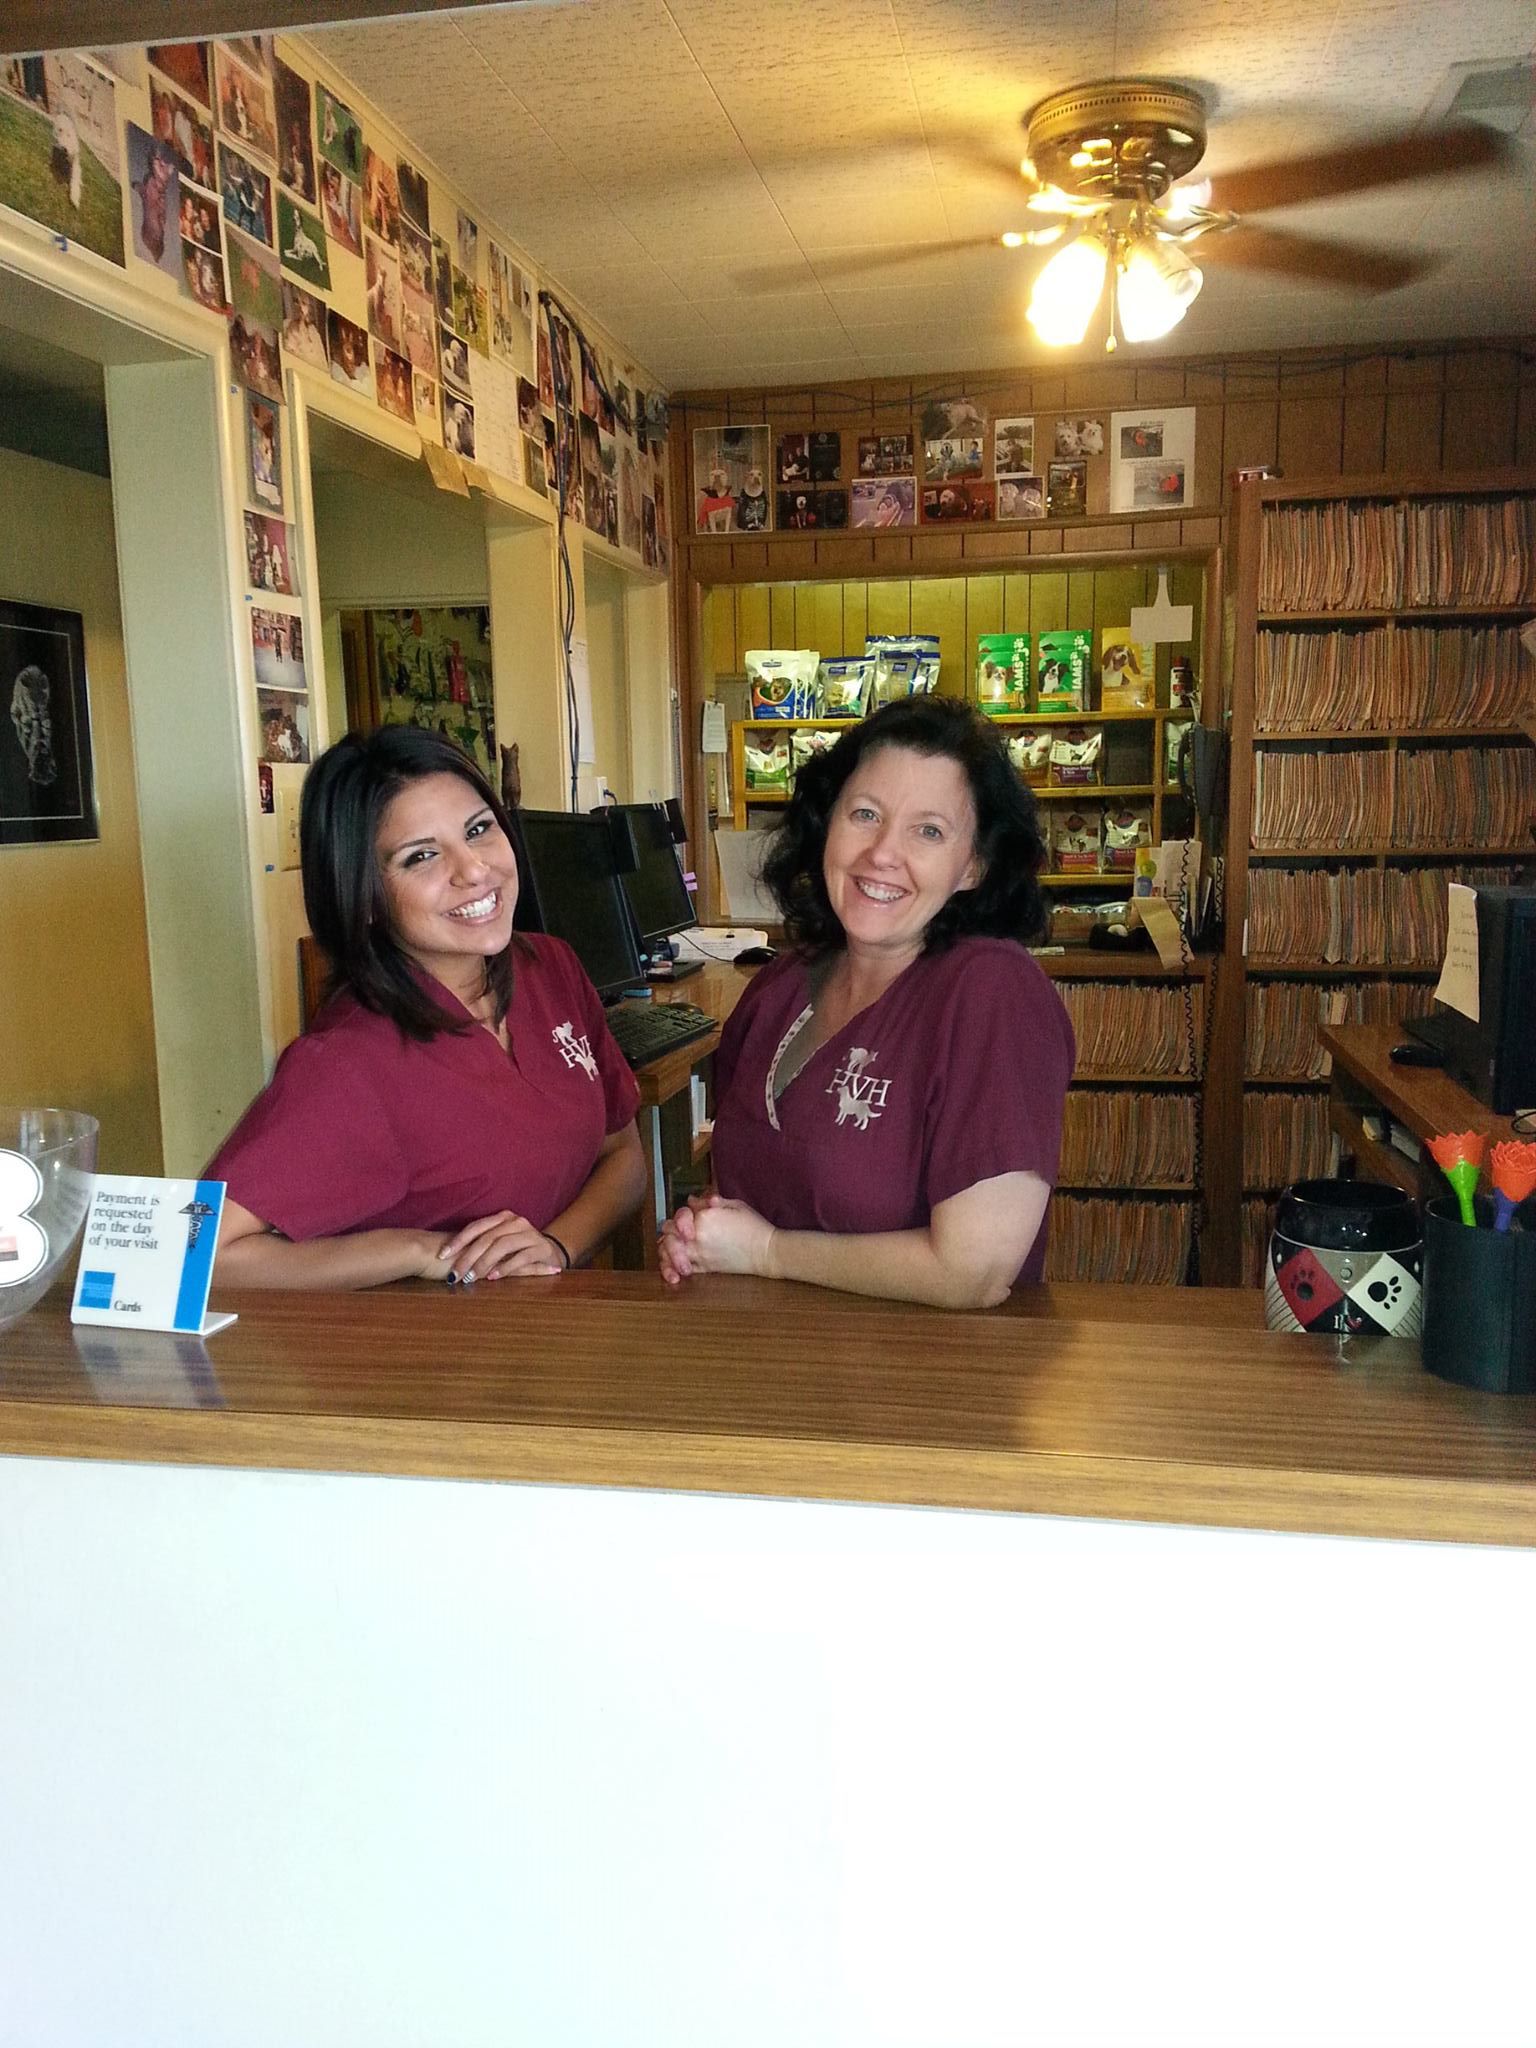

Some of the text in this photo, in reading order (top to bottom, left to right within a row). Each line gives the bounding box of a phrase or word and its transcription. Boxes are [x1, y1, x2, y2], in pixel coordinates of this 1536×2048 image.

[1014, 660, 1024, 691] IAMS
[1072, 659, 1082, 690] IAMS
[825, 1068, 892, 1107] HVH
[96, 1191, 160, 1206] Payment is
[94, 1208, 153, 1220] requested
[91, 1221, 154, 1238] on the day
[89, 1235, 159, 1250] of your visit
[114, 1300, 142, 1312] Cards
